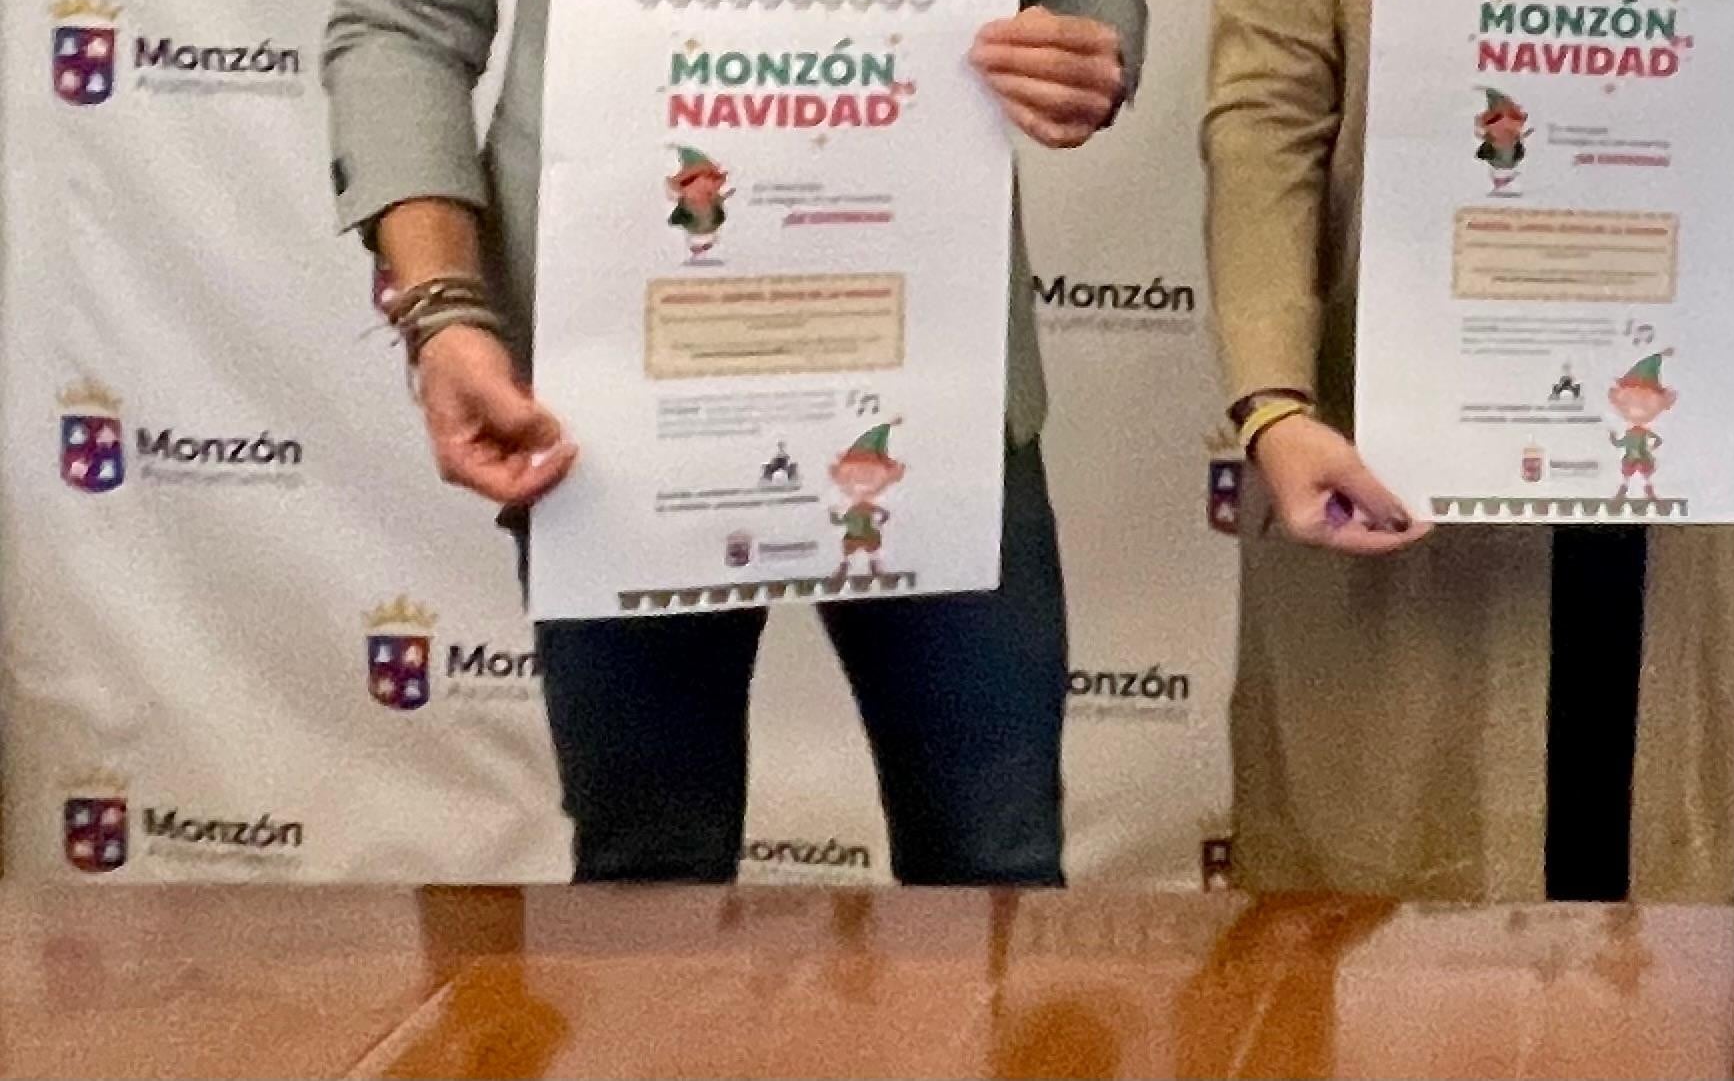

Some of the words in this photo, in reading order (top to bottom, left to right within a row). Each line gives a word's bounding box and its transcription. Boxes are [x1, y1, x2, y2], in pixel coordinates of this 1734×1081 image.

[134, 37, 301, 75] Monzón
[669, 38, 896, 87] MONZÓN
[1477, 41, 1681, 78] NAVIDAD
[667, 93, 901, 129] NAVIDAD
[1031, 275, 1196, 312] Monzón
[136, 428, 303, 465] Monzón
[446, 643, 542, 678] Mon
[1066, 665, 1191, 700] onzón
[143, 807, 303, 849] Monzón
[741, 837, 871, 869] onzón
